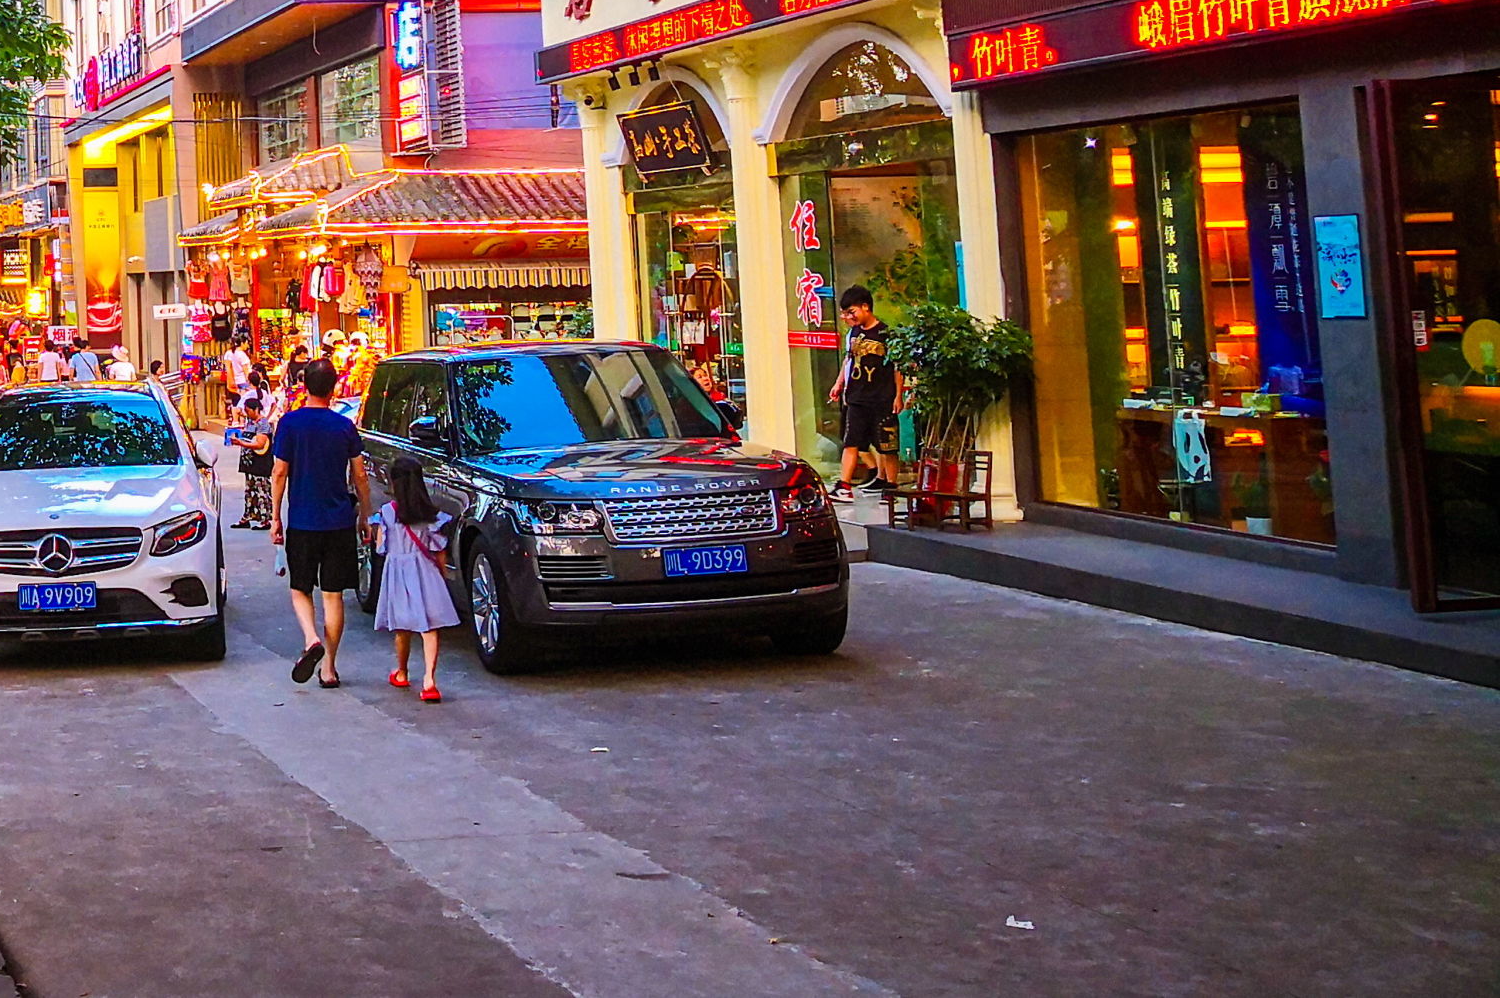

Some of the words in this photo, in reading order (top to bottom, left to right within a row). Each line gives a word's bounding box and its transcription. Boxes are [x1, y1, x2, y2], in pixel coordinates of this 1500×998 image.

[789, 199, 825, 328] 住宿
[610, 484, 681, 494] RANGE
[694, 478, 762, 491] ROVER
